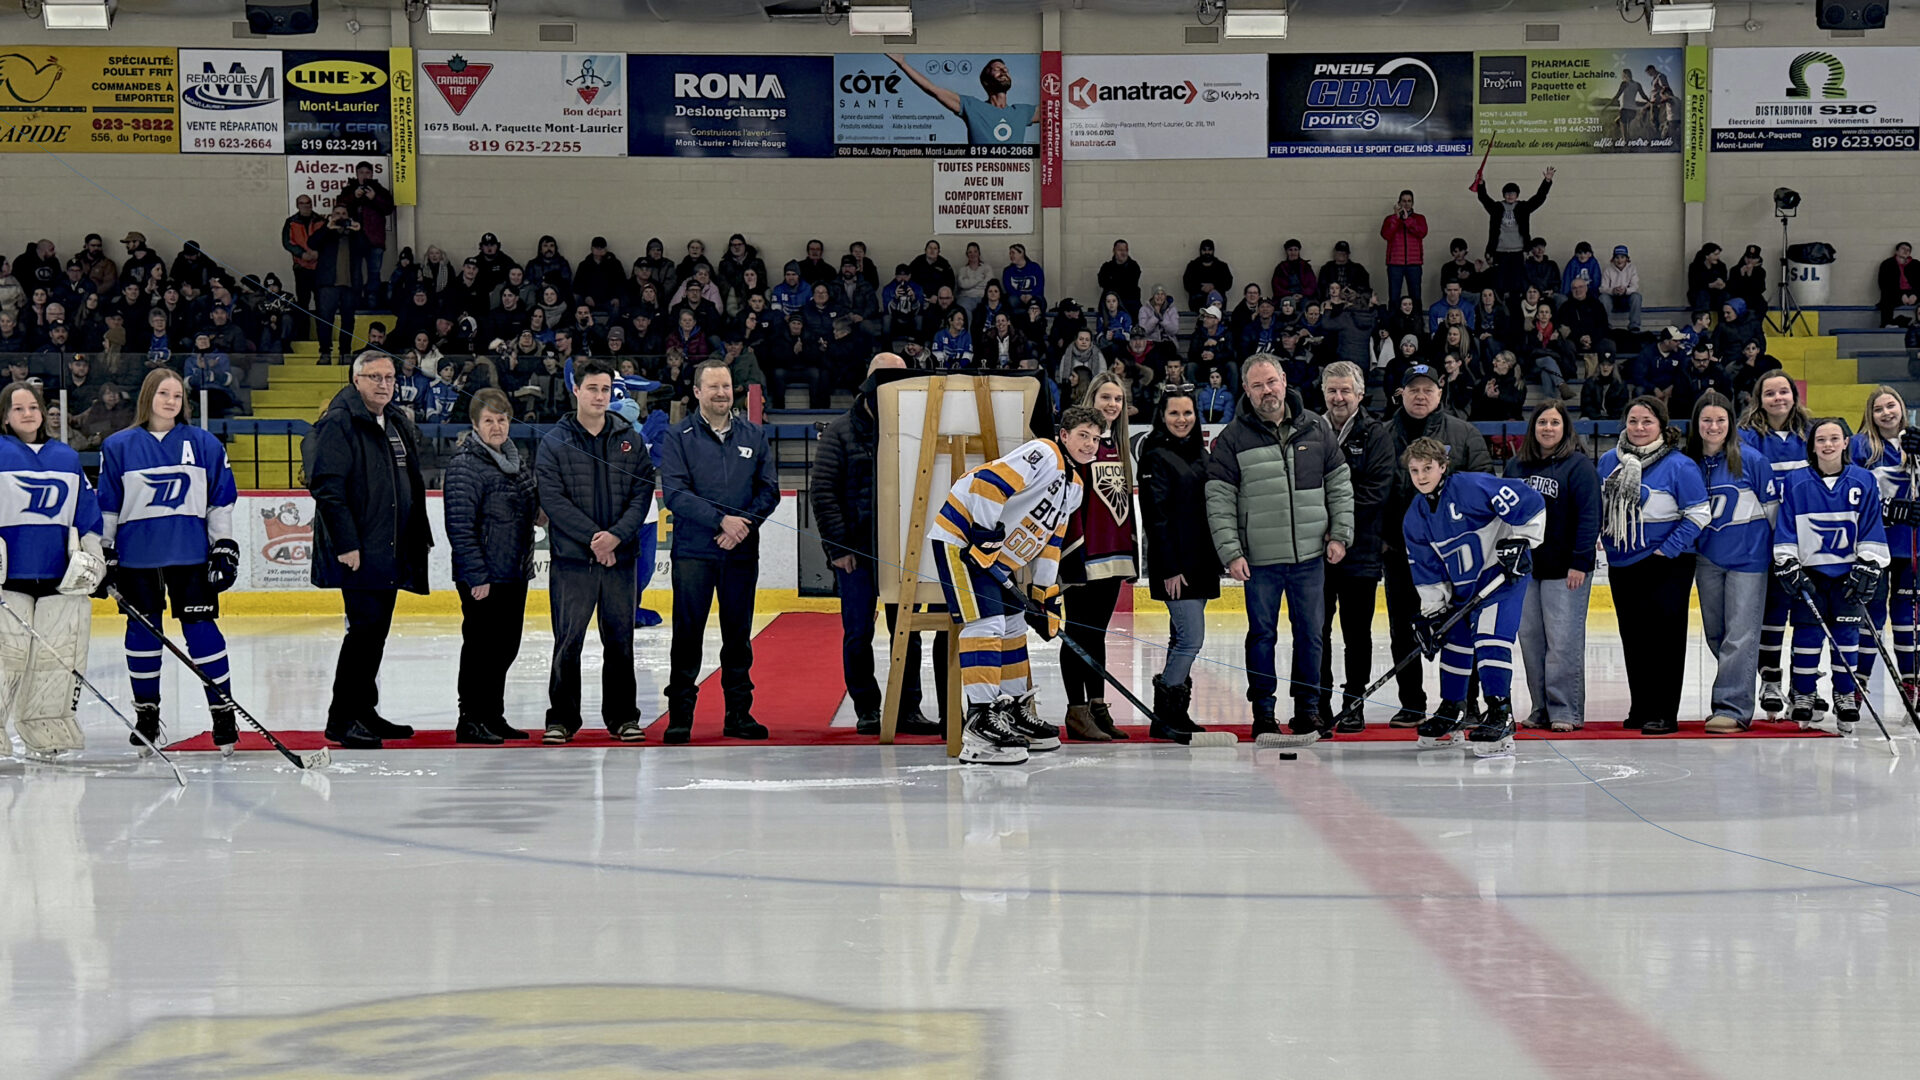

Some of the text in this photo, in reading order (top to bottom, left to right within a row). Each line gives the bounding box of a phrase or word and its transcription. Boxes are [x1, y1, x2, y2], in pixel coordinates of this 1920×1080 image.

[108, 55, 173, 66] SPÉCIALITÉ:
[1531, 60, 1590, 68] PHARMACIE
[103, 68, 173, 77] POULET FRIT
[1314, 63, 1376, 75] PNEUS
[186, 74, 257, 84] REMORQUES
[436, 76, 479, 86] CANADIAN
[1531, 71, 1570, 80] Cloutier,
[92, 80, 173, 91] COMMANDES À
[449, 86, 467, 95] TIRE
[674, 73, 786, 99] RONA
[1531, 82, 1586, 92] Paquette et
[115, 94, 174, 102] EMPORTER
[1221, 90, 1260, 100] Kubota
[1307, 78, 1416, 107] GBM
[1531, 93, 1571, 102] Pelletier
[300, 100, 379, 112] Mont-Laurier
[839, 98, 904, 108] SANTÉ
[563, 107, 622, 117] Bon départ
[674, 105, 787, 120] Deslongchamps
[1755, 104, 1877, 116] DISTRIBUTION SBC
[92, 118, 174, 131] 623-3822
[187, 119, 278, 132] VENTE RÉPARATION
[1308, 113, 1354, 127] point
[1728, 117, 1766, 125] Électricité
[1828, 116, 1869, 125] Vêtements
[288, 122, 389, 132] TRUCK GEAR
[424, 123, 624, 134] 1675 Boul. A. Paquette Mont-Laurier
[690, 127, 772, 137] Construisons l'avenir
[91, 133, 172, 144] 556, du Portage
[1716, 131, 1802, 140] 1950, Boul. A.-Paquette
[194, 138, 272, 149] 819 623-2664
[301, 139, 377, 150] 819 623-2911
[469, 140, 582, 153] 819 623-2255
[675, 139, 786, 148] Mont-Laurier Rivière-Rouge
[1070, 139, 1116, 147] kanatrac.ca
[1478, 139, 1526, 149] Prtenaire
[1529, 139, 1539, 148] de
[1615, 138, 1626, 147] de
[1627, 138, 1649, 147] votre
[1650, 137, 1674, 147] santé
[1716, 141, 1764, 149] Mont-Laurier
[1812, 135, 1915, 148] 819 623.9050
[838, 146, 1034, 157] 600 Boul. Albiny Paquette, Mont-Laurier 819 440-2068
[1270, 144, 1466, 154] FIER D'ENCOURAGER LE SPORT CHEZ NOS JEUNES
[294, 160, 383, 174] Aidez-ns
[938, 162, 1030, 172] TOUTES PERSONNES
[401, 165, 409, 183] Inc.
[306, 176, 315, 190] à
[964, 177, 1004, 186] AVEC UN
[945, 191, 1023, 201] COMPORTEMENT
[938, 203, 1030, 215] INADÉQUAT SERONT
[955, 217, 1012, 229] EXPULSÉES.
[1790, 267, 1820, 281] SJL
[180, 440, 196, 465] A
[1524, 474, 1559, 498] EURS
[1491, 485, 1520, 516] 39
[1848, 487, 1862, 505] C
